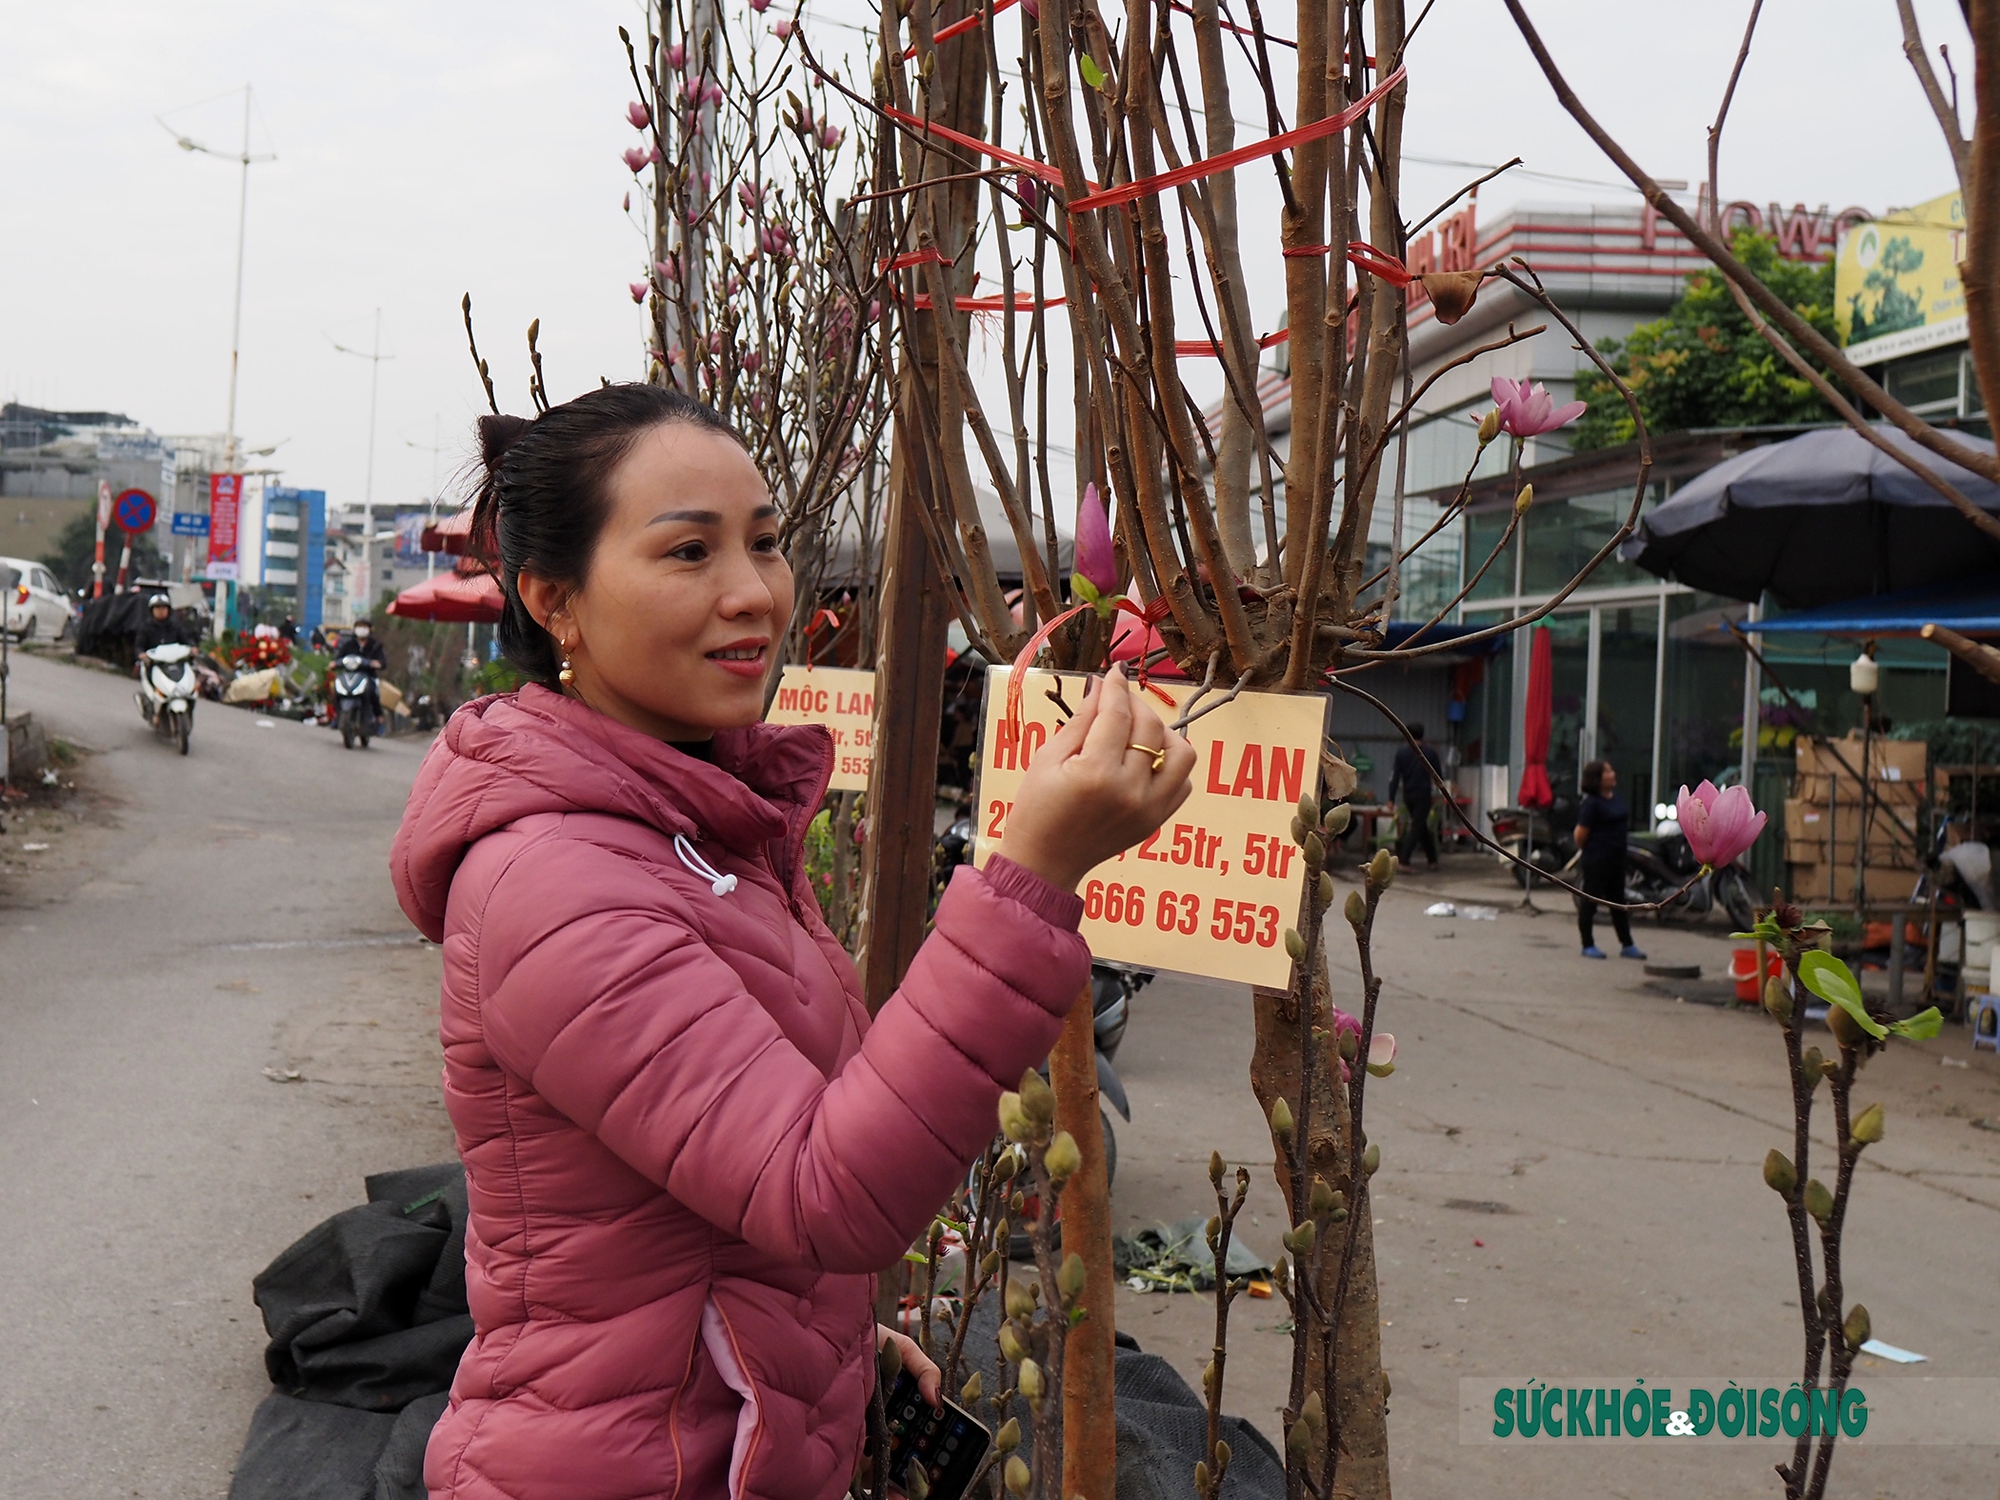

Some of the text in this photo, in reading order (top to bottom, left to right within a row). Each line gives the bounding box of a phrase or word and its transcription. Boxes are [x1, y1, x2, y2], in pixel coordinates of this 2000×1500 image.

[778, 684, 875, 717] MỘC LAN
[841, 756, 870, 776] 553
[1206, 740, 1306, 804] LAN
[1242, 832, 1297, 879] 5tr
[1084, 879, 1281, 949] 666 63 553
